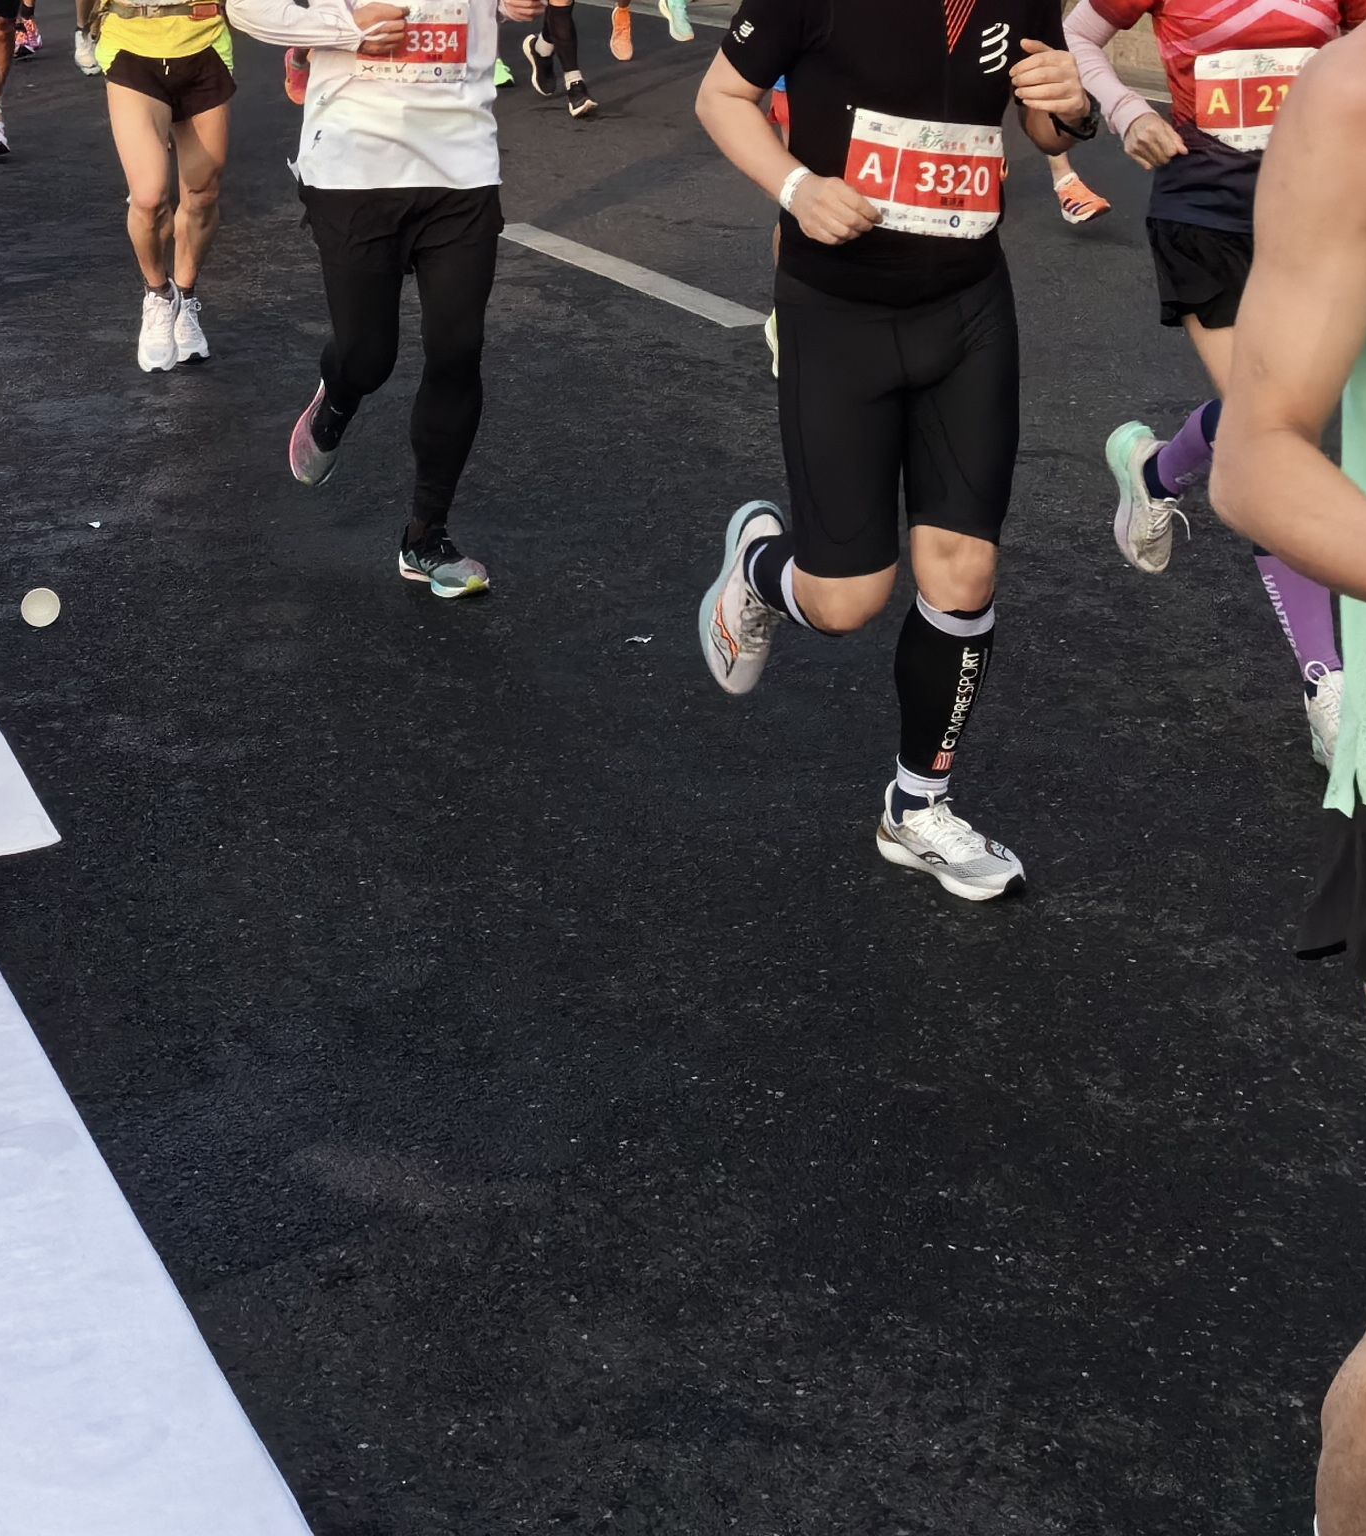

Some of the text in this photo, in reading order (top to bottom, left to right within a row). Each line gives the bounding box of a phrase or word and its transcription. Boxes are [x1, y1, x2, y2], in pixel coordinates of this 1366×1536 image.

[405, 30, 459, 53] 3334
[1206, 87, 1231, 115] A
[857, 152, 990, 197] A 3320
